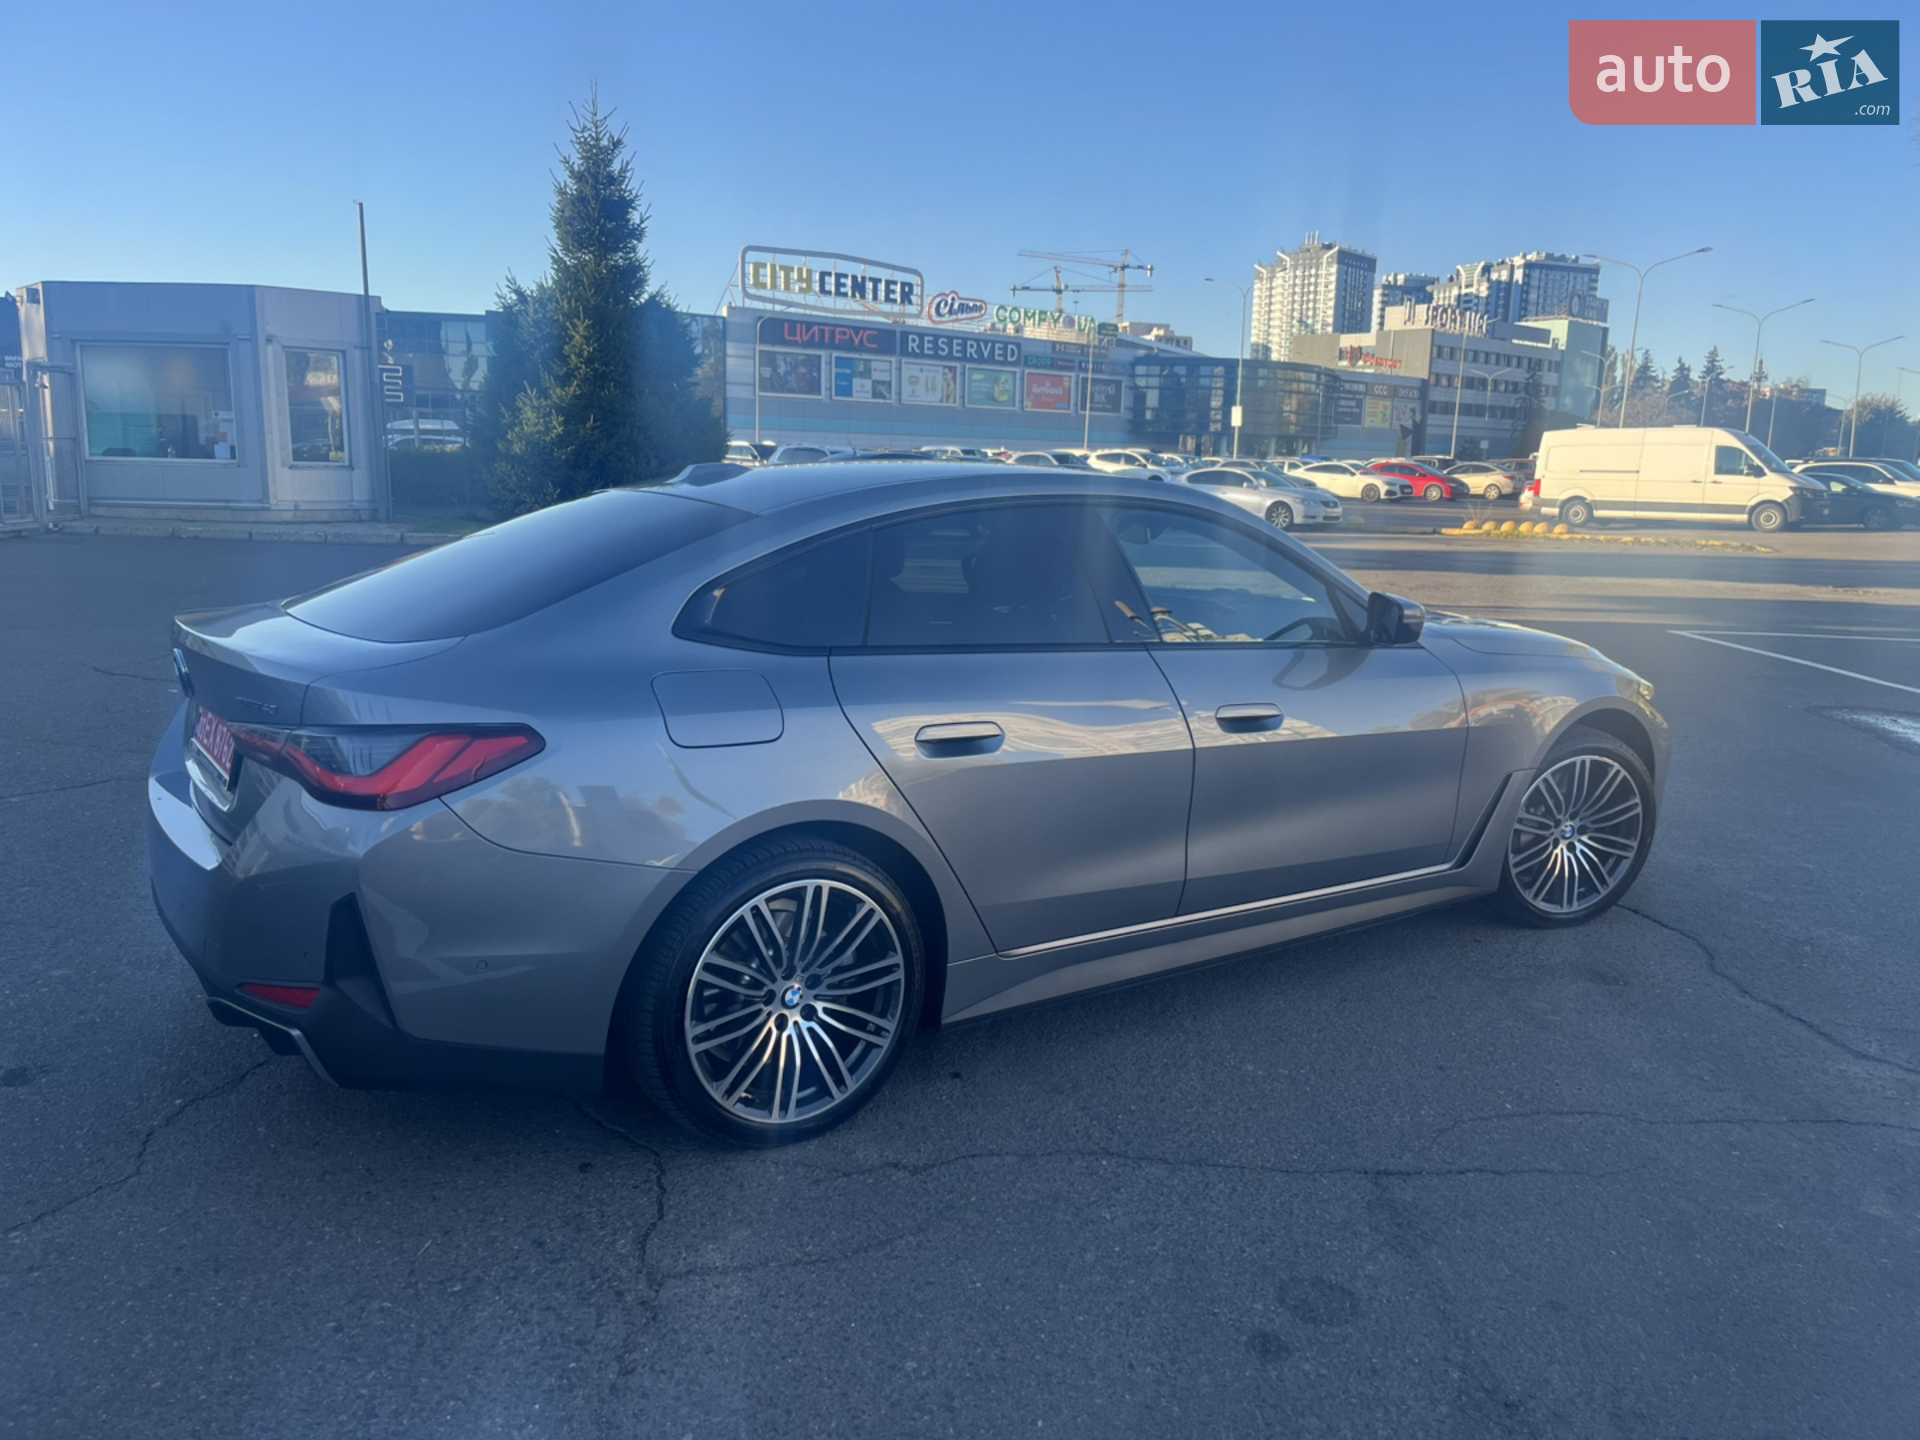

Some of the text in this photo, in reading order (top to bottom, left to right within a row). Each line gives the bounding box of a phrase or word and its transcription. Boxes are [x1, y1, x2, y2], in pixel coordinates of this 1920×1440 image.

[750, 262, 914, 305] CITY CENTER
[935, 296, 984, 317] Сільпо
[783, 321, 878, 348] ЦИТРУС
[907, 334, 1019, 363] RESERVED
